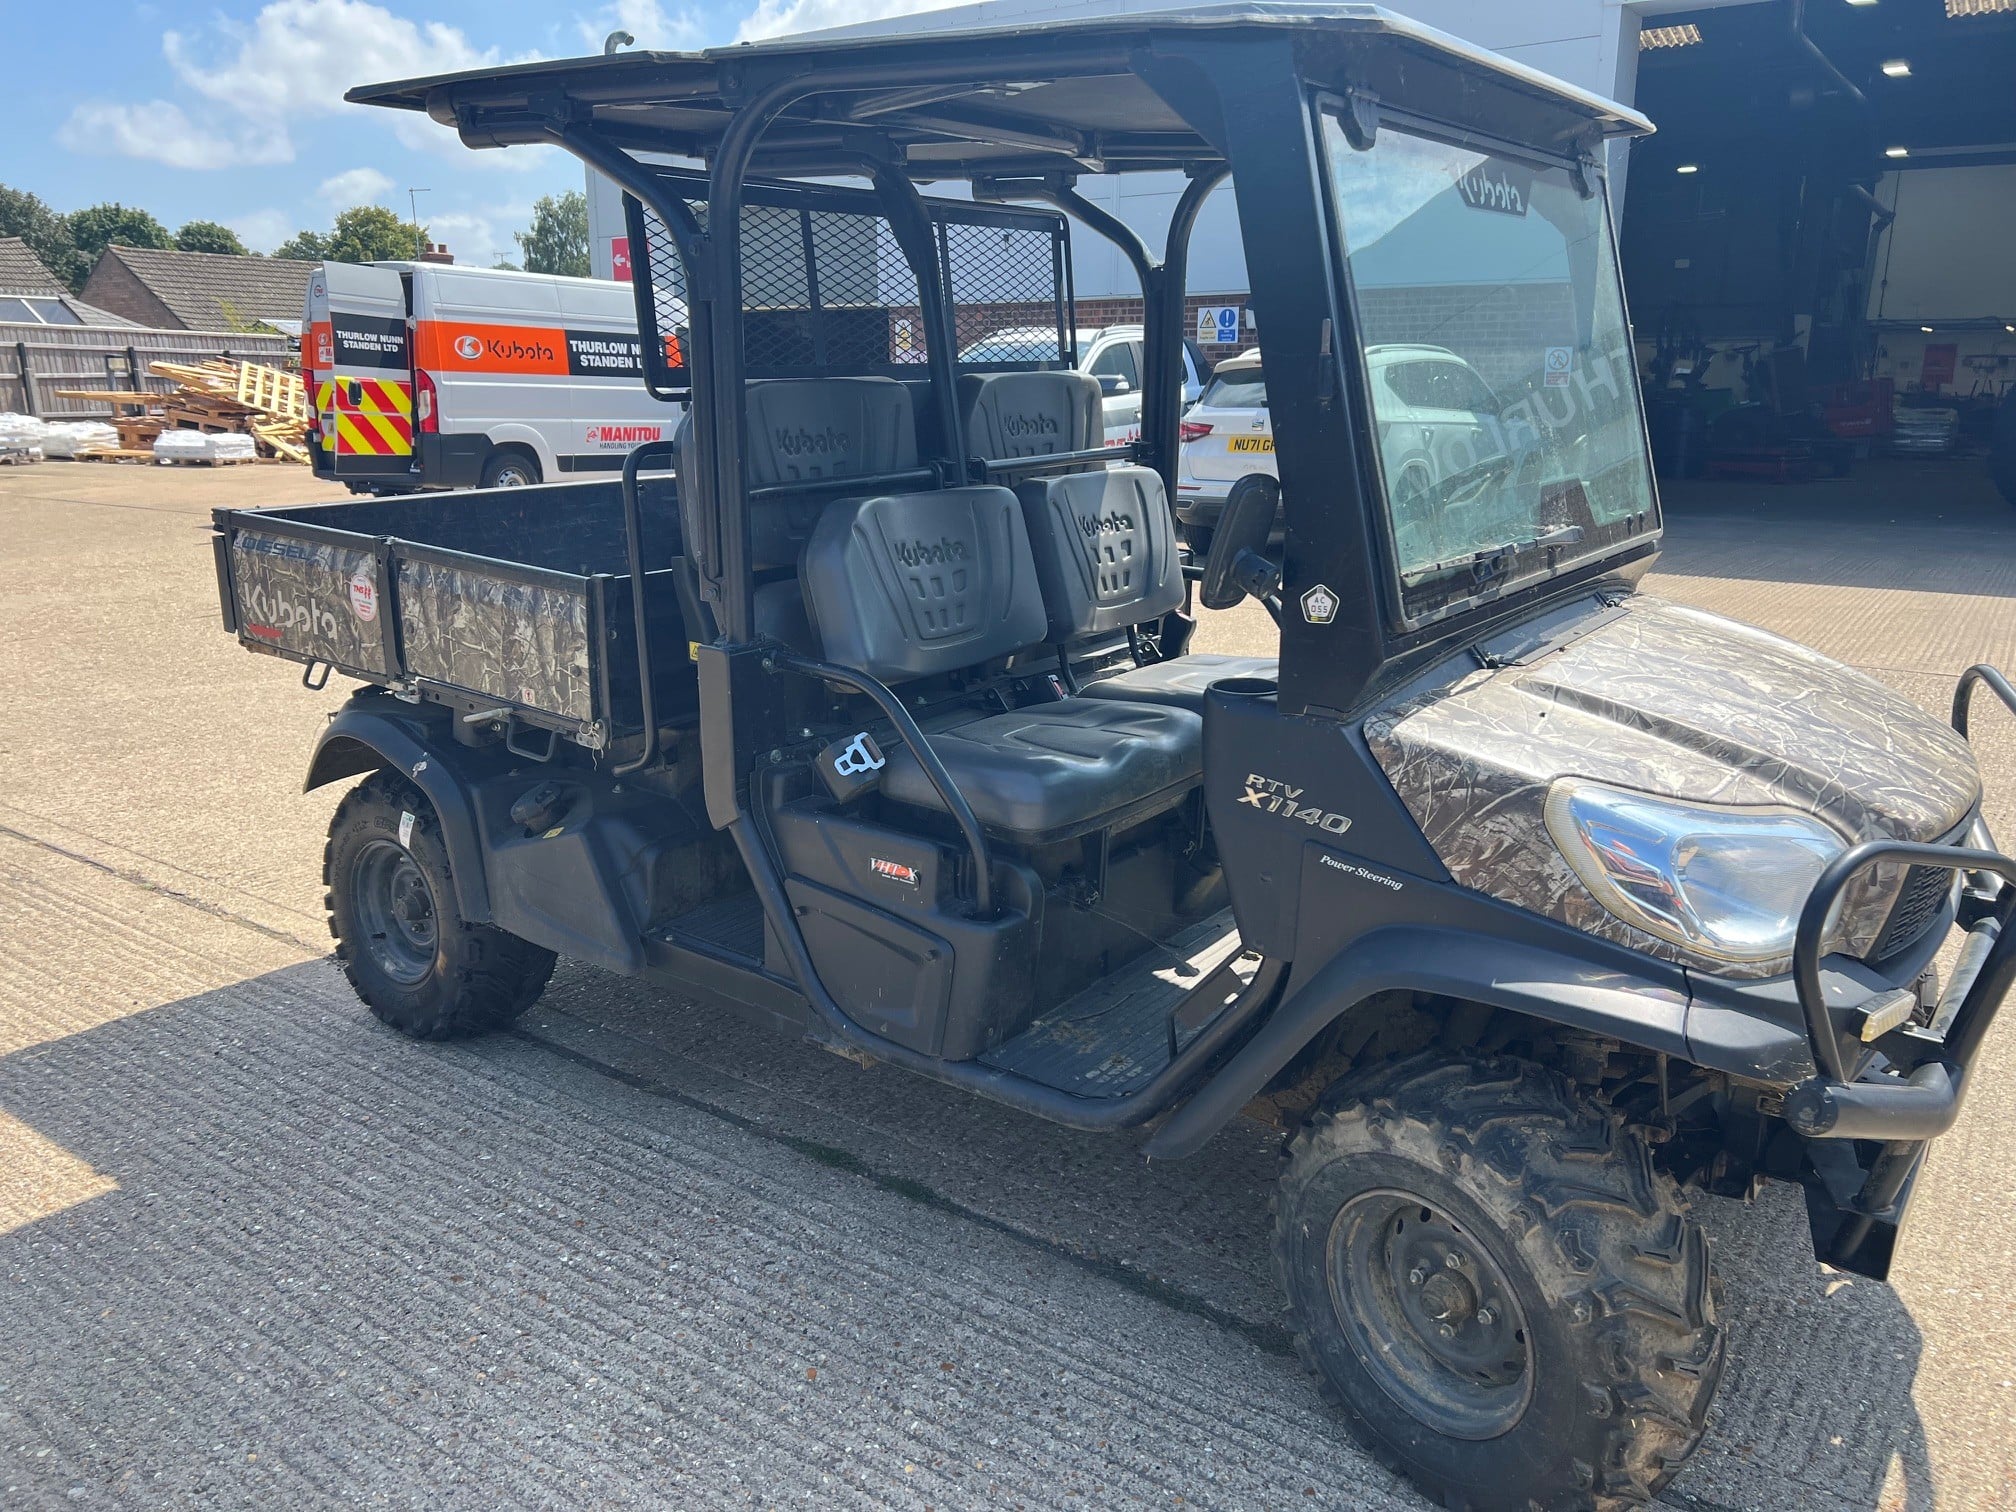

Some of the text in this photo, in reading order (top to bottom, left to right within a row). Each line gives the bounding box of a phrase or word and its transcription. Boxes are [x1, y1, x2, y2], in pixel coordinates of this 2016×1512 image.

[1457, 163, 1525, 213] Kubota
[335, 330, 404, 345] THURLOW NUNN
[343, 340, 399, 353] STANDEN LTD
[569, 340, 627, 355] THURLOW
[487, 339, 554, 361] Kubota
[580, 354, 634, 369] STANDEN
[600, 426, 661, 442] MANITOU
[1004, 413, 1058, 437] Kubota
[600, 442, 627, 450] HANDLING
[776, 426, 849, 456] Kubota
[1233, 439, 1261, 451] NU71
[1078, 511, 1134, 538] Kubota
[893, 537, 970, 567] Kubota
[244, 582, 338, 640] Kubota
[1245, 773, 1304, 799] RTV
[1236, 786, 1353, 834] X1140
[1320, 854, 1404, 891] Power Steering
